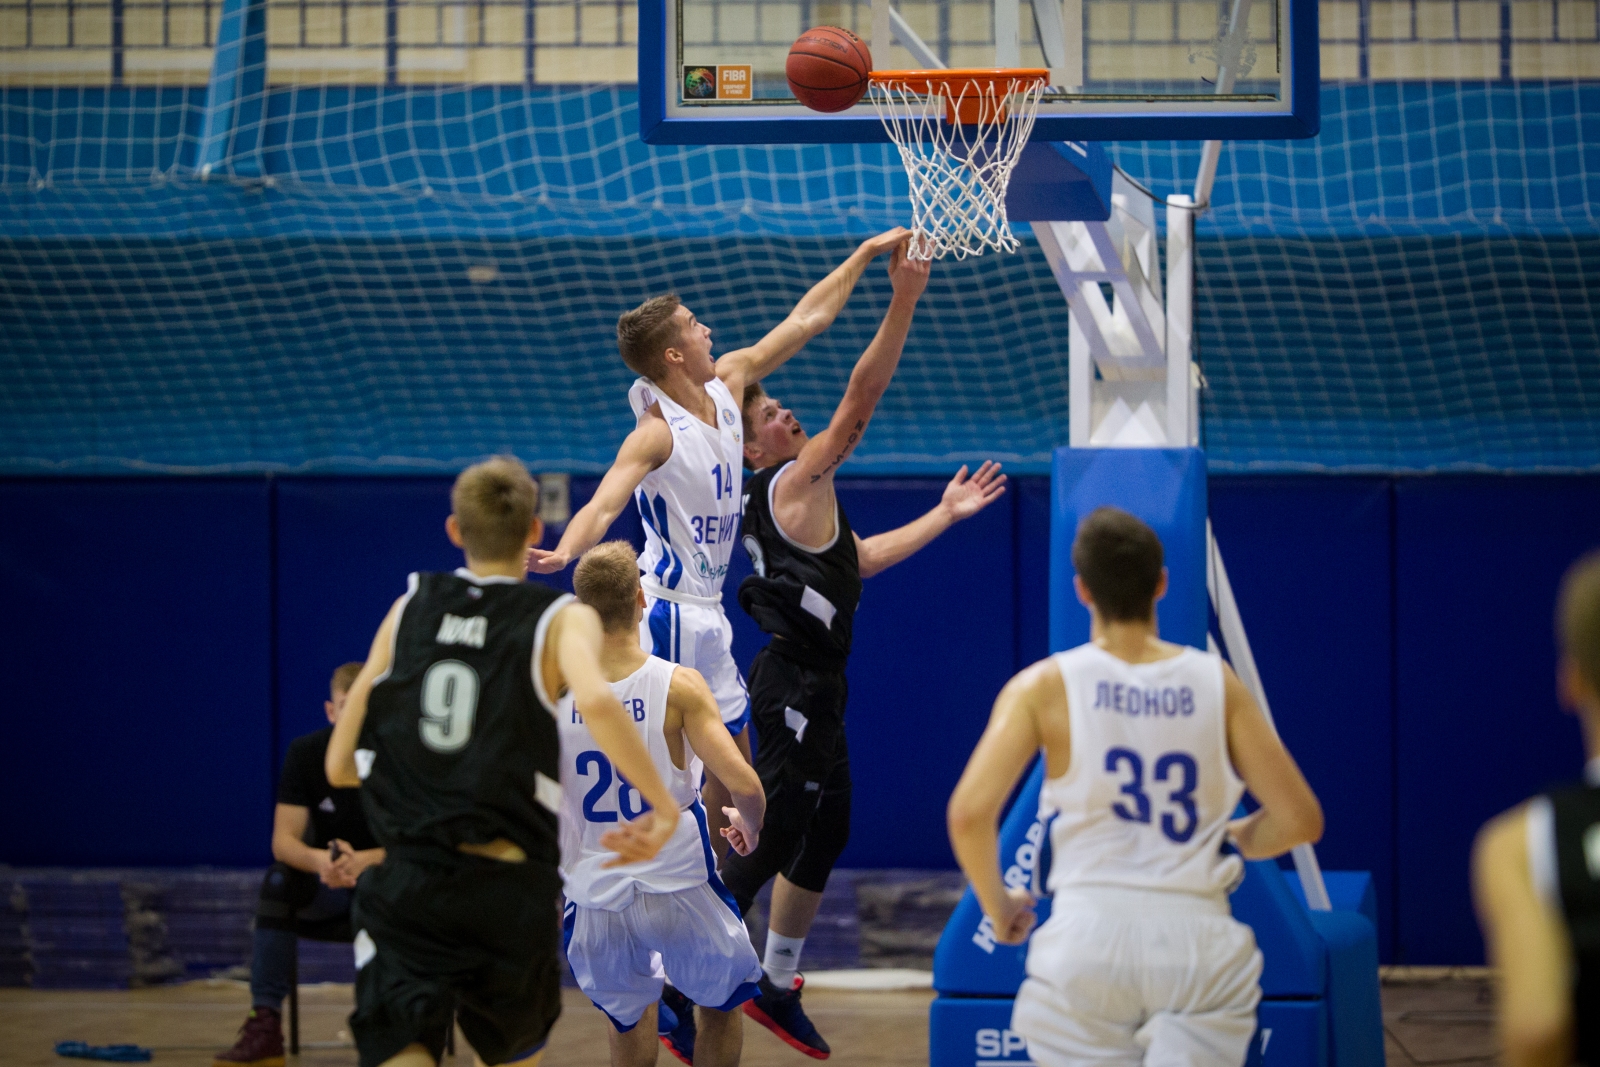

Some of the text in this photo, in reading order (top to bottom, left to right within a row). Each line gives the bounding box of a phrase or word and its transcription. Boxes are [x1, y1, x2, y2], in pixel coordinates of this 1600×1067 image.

[722, 69, 747, 82] FIBA
[711, 462, 733, 500] 14
[418, 658, 480, 754] 9
[1093, 680, 1196, 718] ЛЕОНОВ
[1104, 746, 1199, 845] 33
